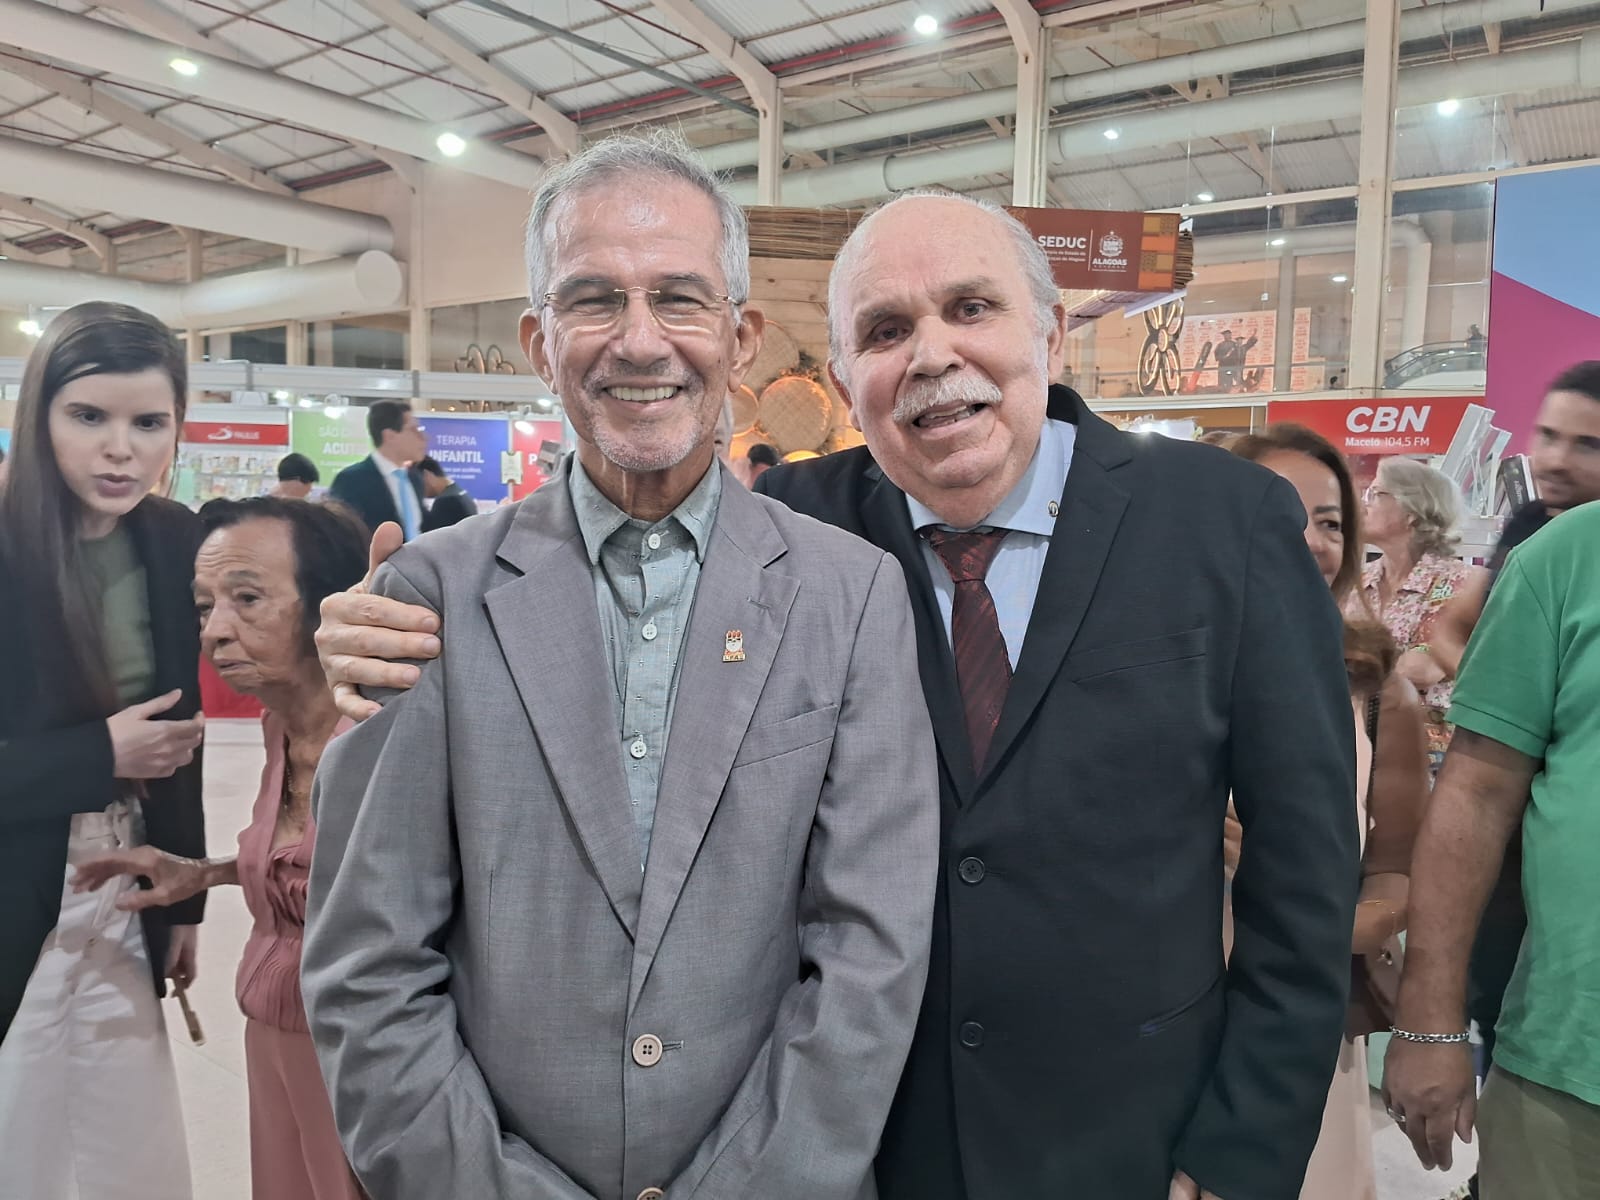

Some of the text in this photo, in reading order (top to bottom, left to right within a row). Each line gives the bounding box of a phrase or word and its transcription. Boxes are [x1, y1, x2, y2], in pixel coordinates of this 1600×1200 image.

[1038, 235, 1087, 249] SEDUC
[1092, 258, 1128, 266] ALAGOAS
[1346, 406, 1431, 433] CBN
[436, 434, 477, 446] TERAPIA
[1414, 437, 1430, 447] FM
[429, 449, 485, 464] INFANTIL
